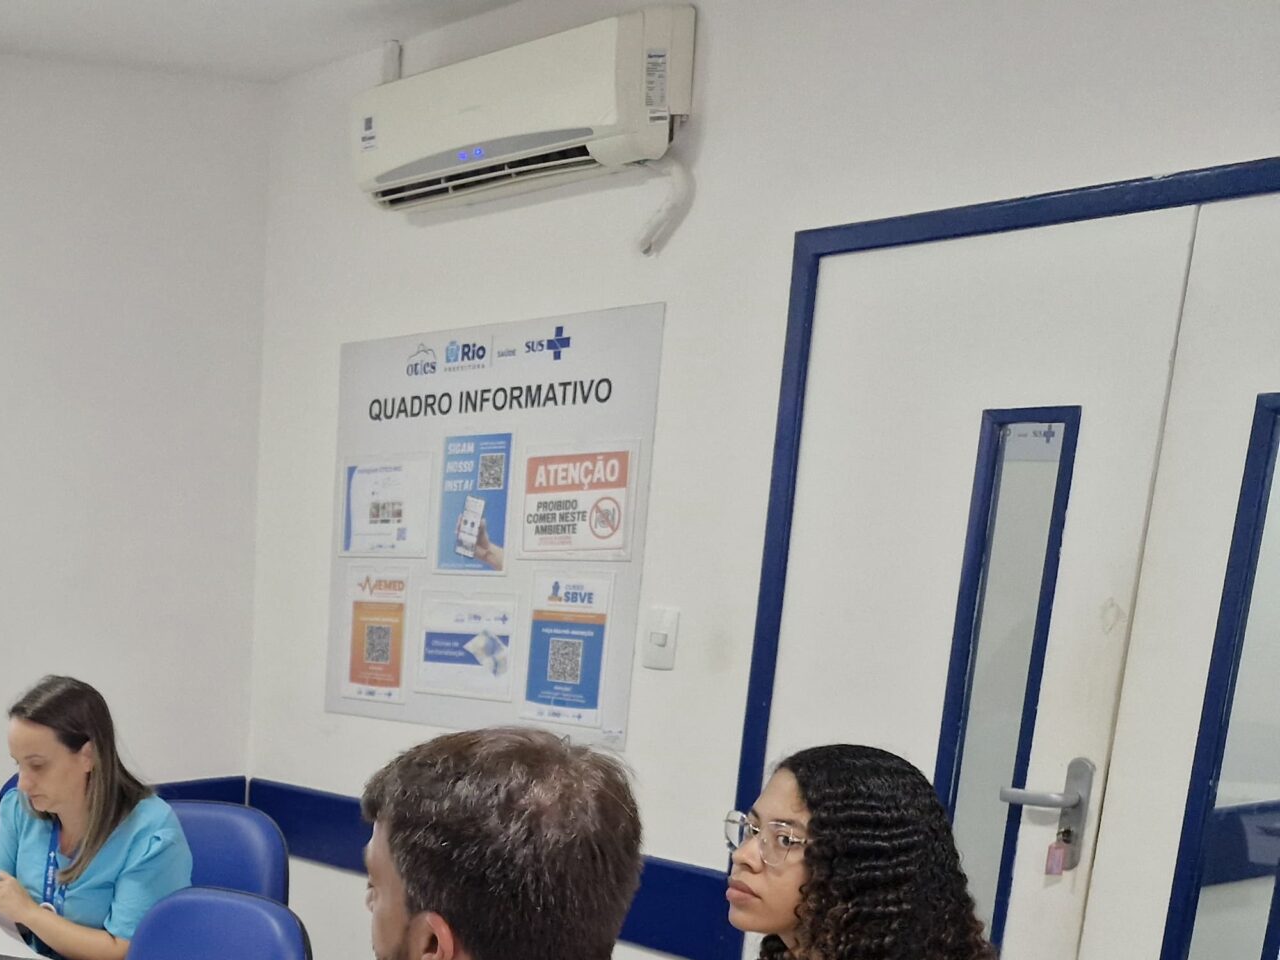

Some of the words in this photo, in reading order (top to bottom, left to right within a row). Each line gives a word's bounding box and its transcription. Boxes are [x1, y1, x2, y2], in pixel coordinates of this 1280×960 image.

[461, 342, 486, 361] Rio
[524, 340, 545, 353] SUS
[369, 391, 453, 421] QUADRO
[458, 377, 613, 414] INFORMATIVO
[447, 442, 475, 454] SIGAM
[446, 460, 475, 473] NOSSO
[534, 456, 619, 490] ATENÇÃO
[536, 499, 578, 511] PROIBIDO
[526, 511, 557, 524] COMER
[558, 510, 587, 523] NESTE
[534, 523, 578, 536] AMBIENTE
[563, 591, 594, 604] SBVE
